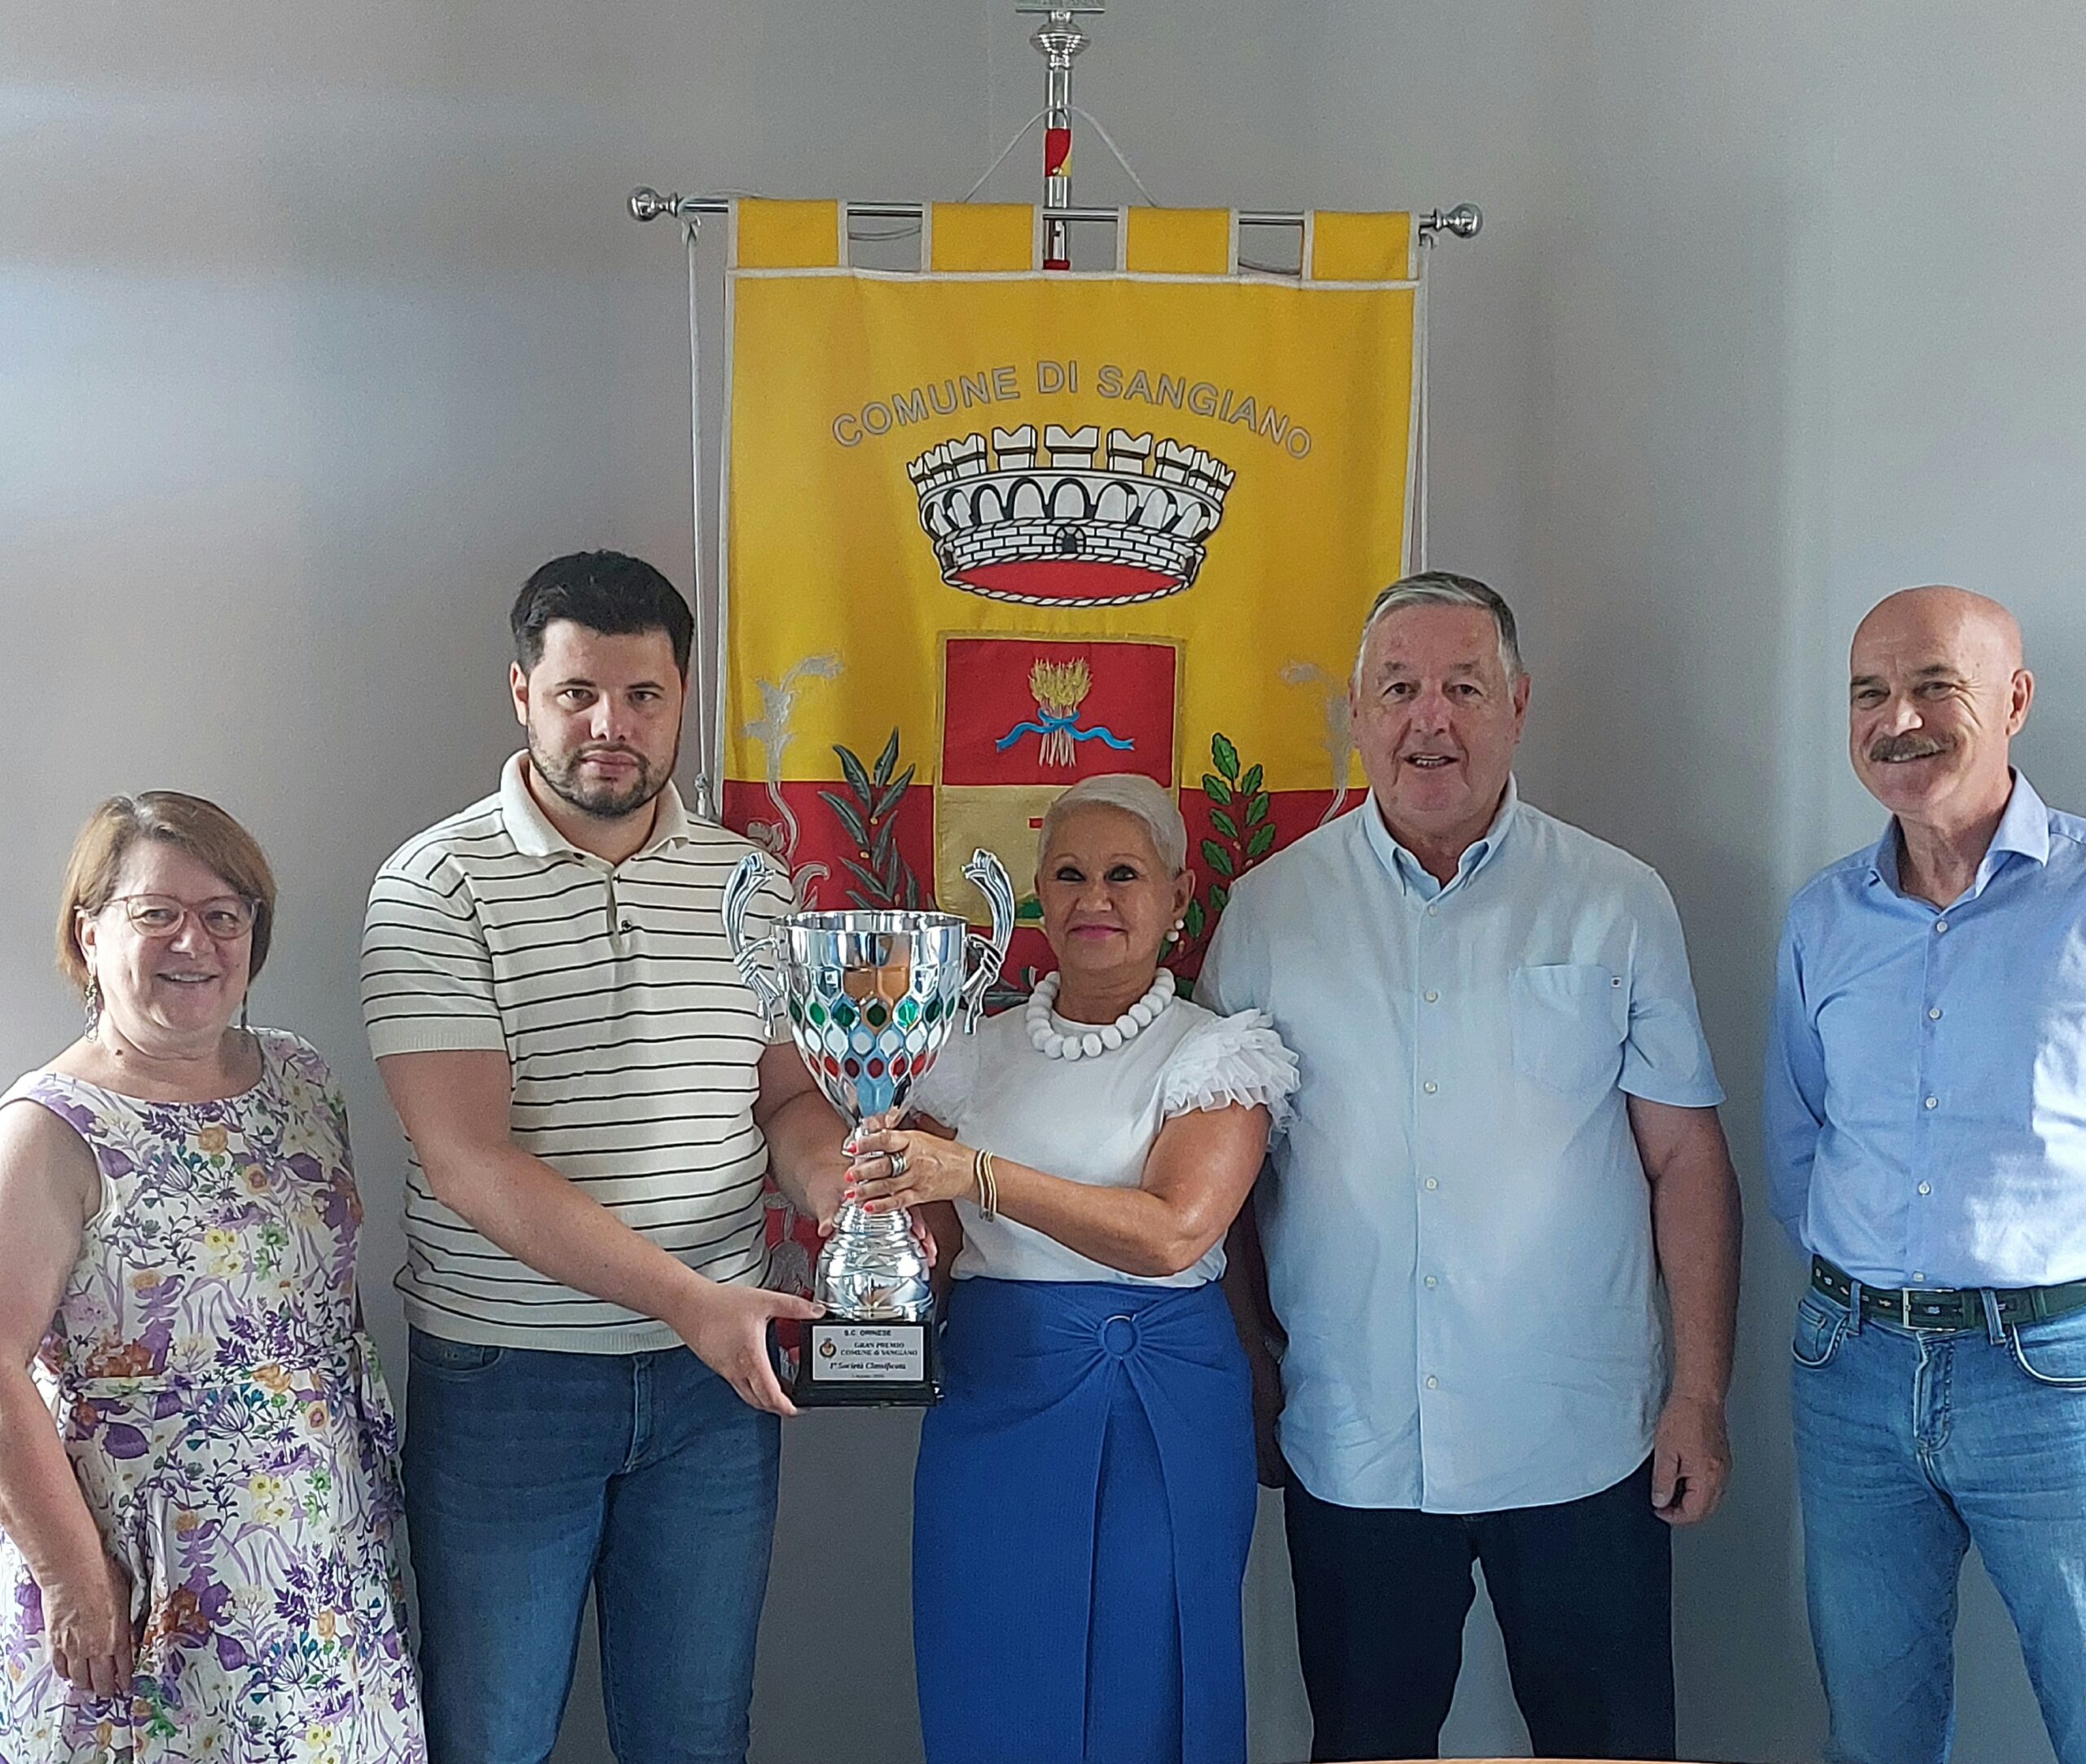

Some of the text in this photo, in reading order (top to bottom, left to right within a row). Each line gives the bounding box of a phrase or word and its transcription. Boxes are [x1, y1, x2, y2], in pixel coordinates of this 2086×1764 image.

[832, 359, 1313, 460] COMUNE DI SANGIANO
